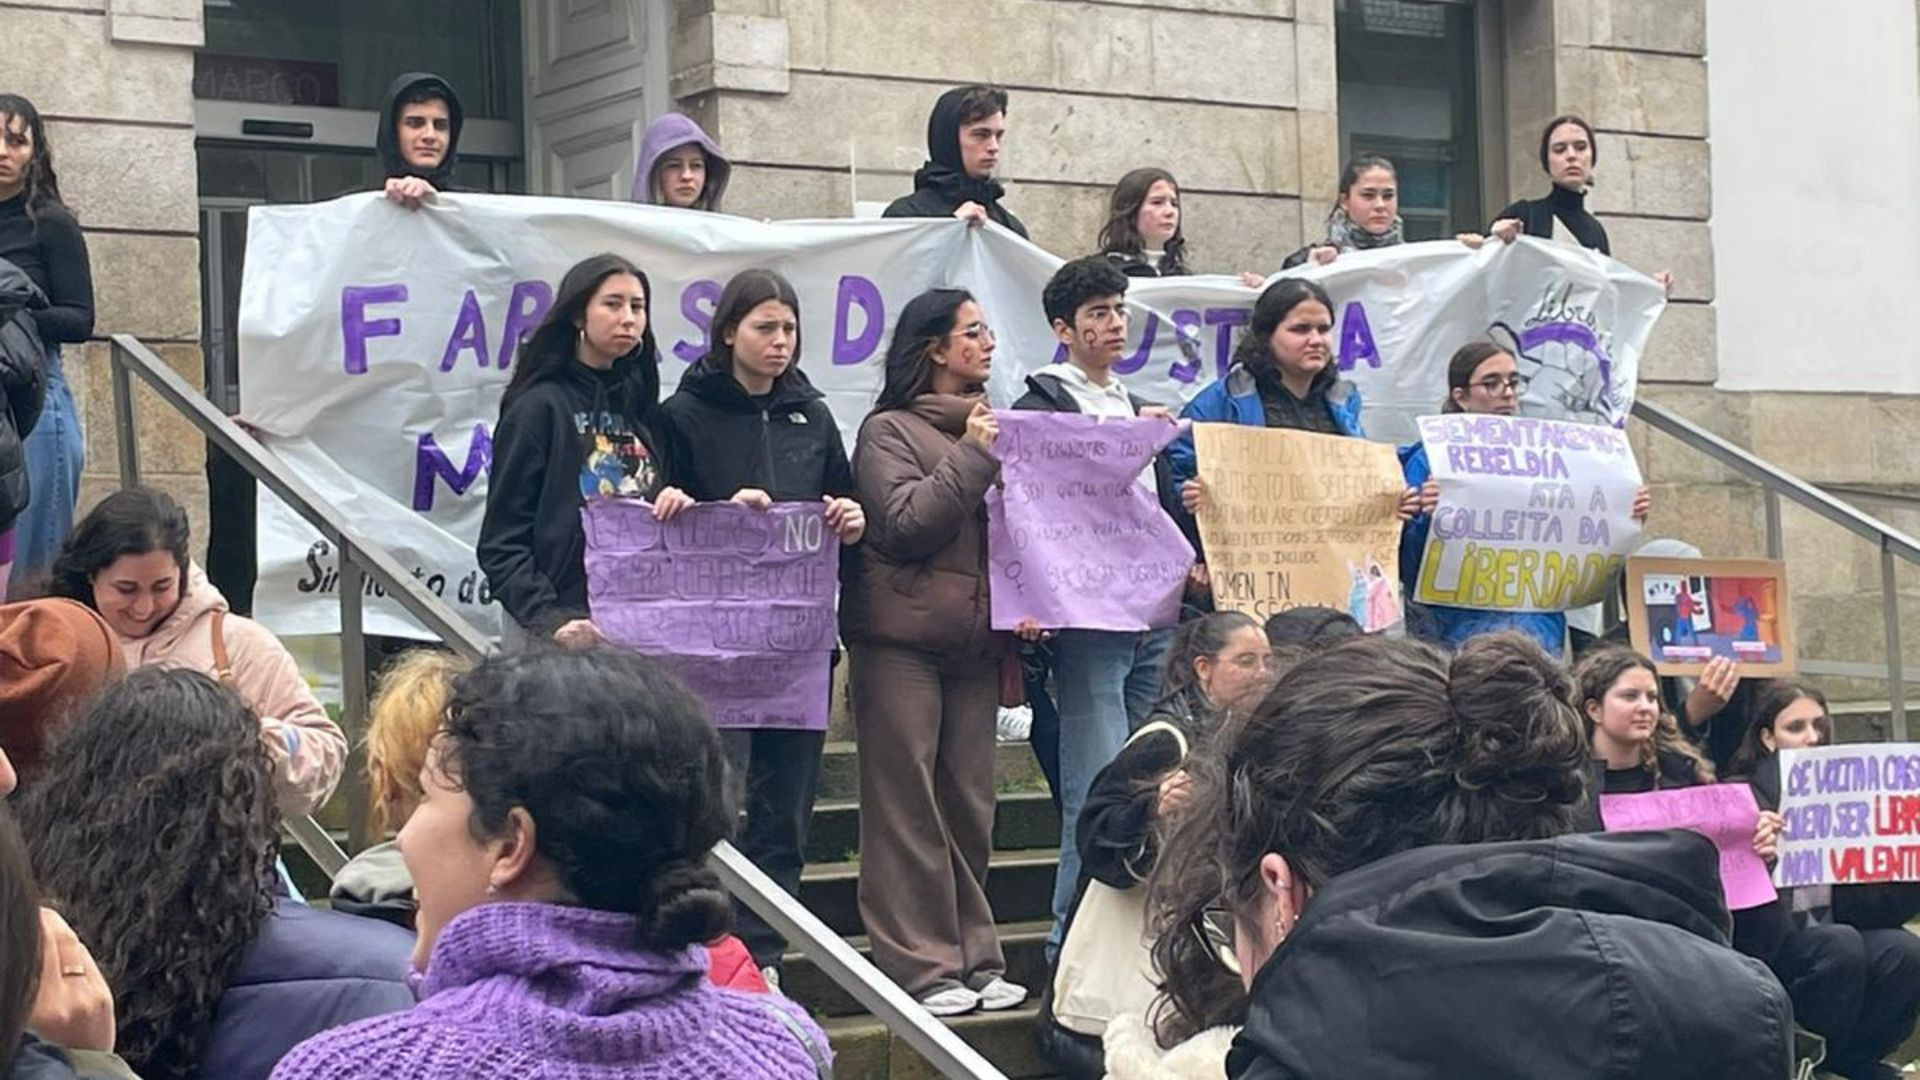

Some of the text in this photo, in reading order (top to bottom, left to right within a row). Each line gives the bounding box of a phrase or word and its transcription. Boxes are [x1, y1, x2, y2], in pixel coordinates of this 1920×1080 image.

[1423, 416, 1626, 455] SEMENTAREMOS
[1447, 445, 1569, 479] REBELDÍA
[1529, 480, 1608, 512] ATA A
[784, 514, 822, 552] NO
[1433, 506, 1563, 543] COLLEITA
[1578, 515, 1610, 547] DA
[1265, 571, 1290, 600] IN
[1788, 759, 1812, 797] DE
[1832, 801, 1870, 838] SER
[1781, 847, 1823, 885] NON
